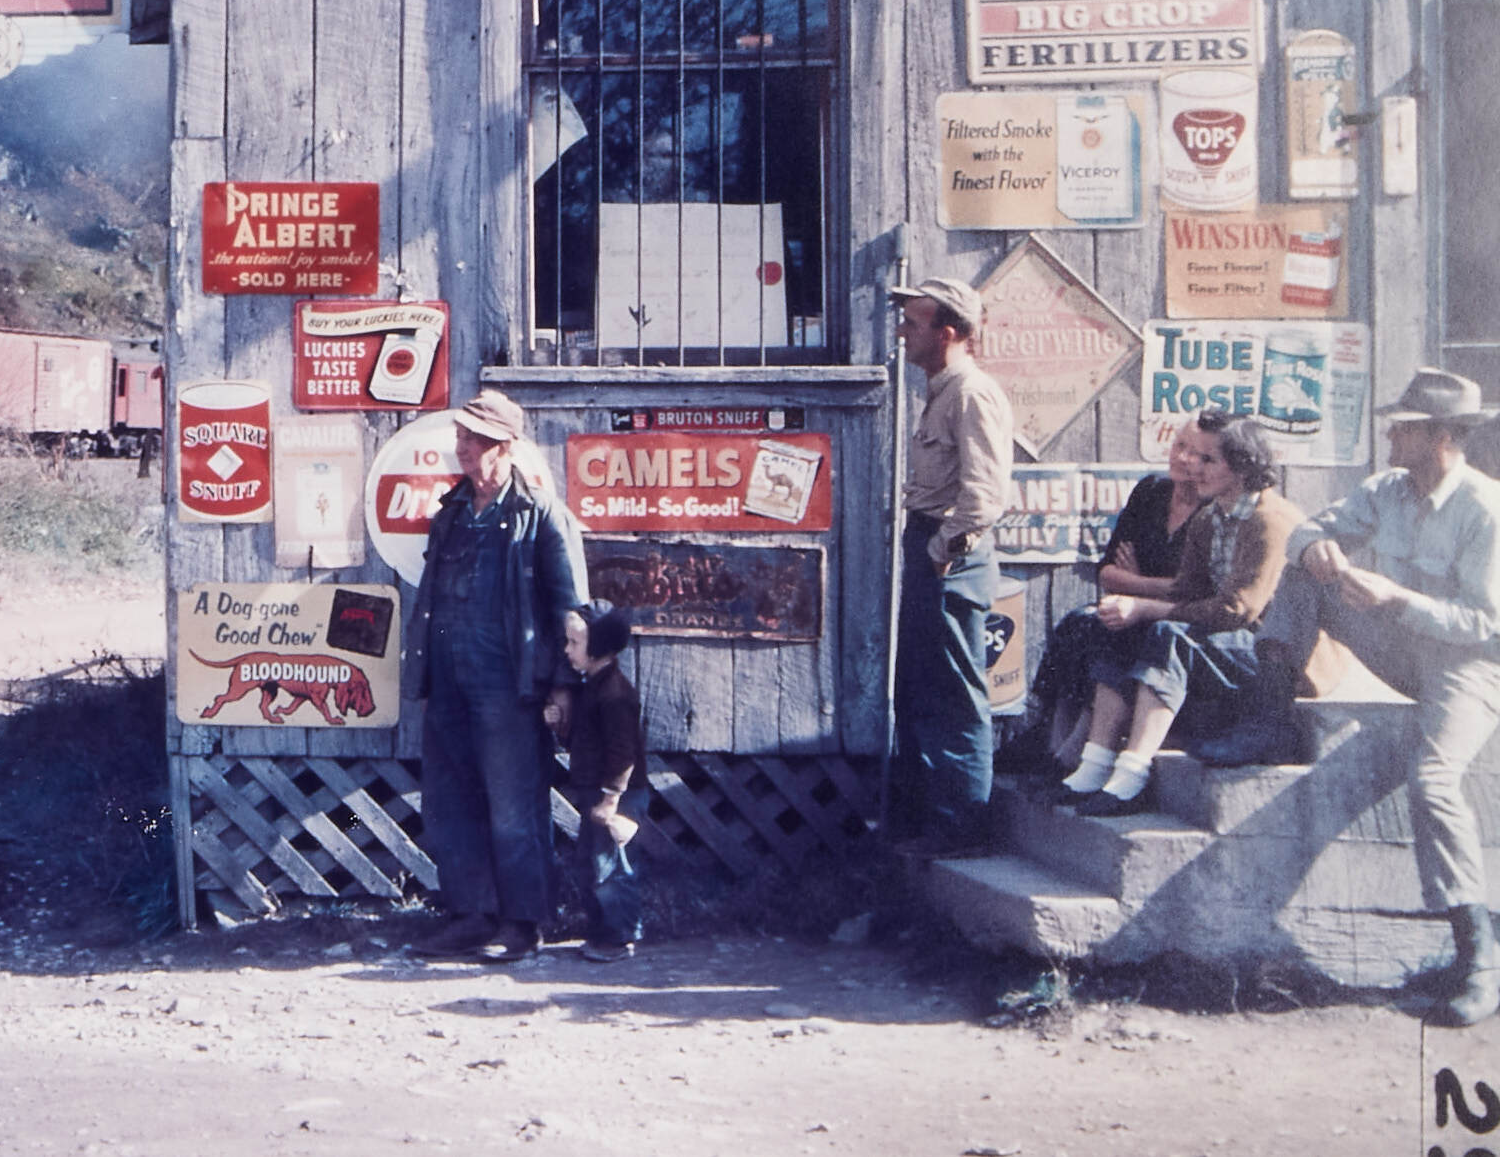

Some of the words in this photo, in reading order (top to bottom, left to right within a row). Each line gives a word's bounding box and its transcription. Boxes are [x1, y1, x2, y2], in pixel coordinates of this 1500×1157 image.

[1016, 3, 1090, 30] BIG
[1101, 0, 1218, 27] CROP
[982, 37, 1249, 67] FERTILIZERS
[1001, 118, 1052, 139] Smoke
[1185, 125, 1237, 150] TOPS
[972, 148, 1004, 162] with
[1006, 147, 1024, 162] the
[952, 170, 995, 190] Finest
[1060, 165, 1121, 180] VICEROY
[232, 213, 357, 248] ALBERT
[1171, 218, 1287, 250] WINSTON
[236, 251, 292, 265] national
[292, 252, 316, 269] joy
[308, 317, 331, 329] BUY
[334, 316, 363, 329] YOUR
[364, 312, 406, 327] LUCKIES
[982, 321, 1120, 356] heerwine
[304, 341, 366, 358] LUCKIES
[1156, 328, 1254, 371] TUBE
[312, 360, 357, 377] TASTE
[307, 379, 361, 396] BETTER
[1152, 372, 1255, 416] ROSE
[657, 410, 714, 426] BRUTON
[716, 410, 760, 425] SNUFF
[183, 421, 268, 449] SQUARE
[577, 448, 743, 488] CAMELS
[189, 480, 262, 502] SNUFF
[1008, 478, 1070, 512] ANS
[1074, 471, 1138, 512] DOW
[580, 497, 606, 517] So
[684, 497, 740, 517] Good!
[993, 526, 1059, 547] MILY
[1067, 526, 1112, 547] FLO
[215, 622, 262, 644] Good
[240, 663, 352, 684] BLOODHOUND
